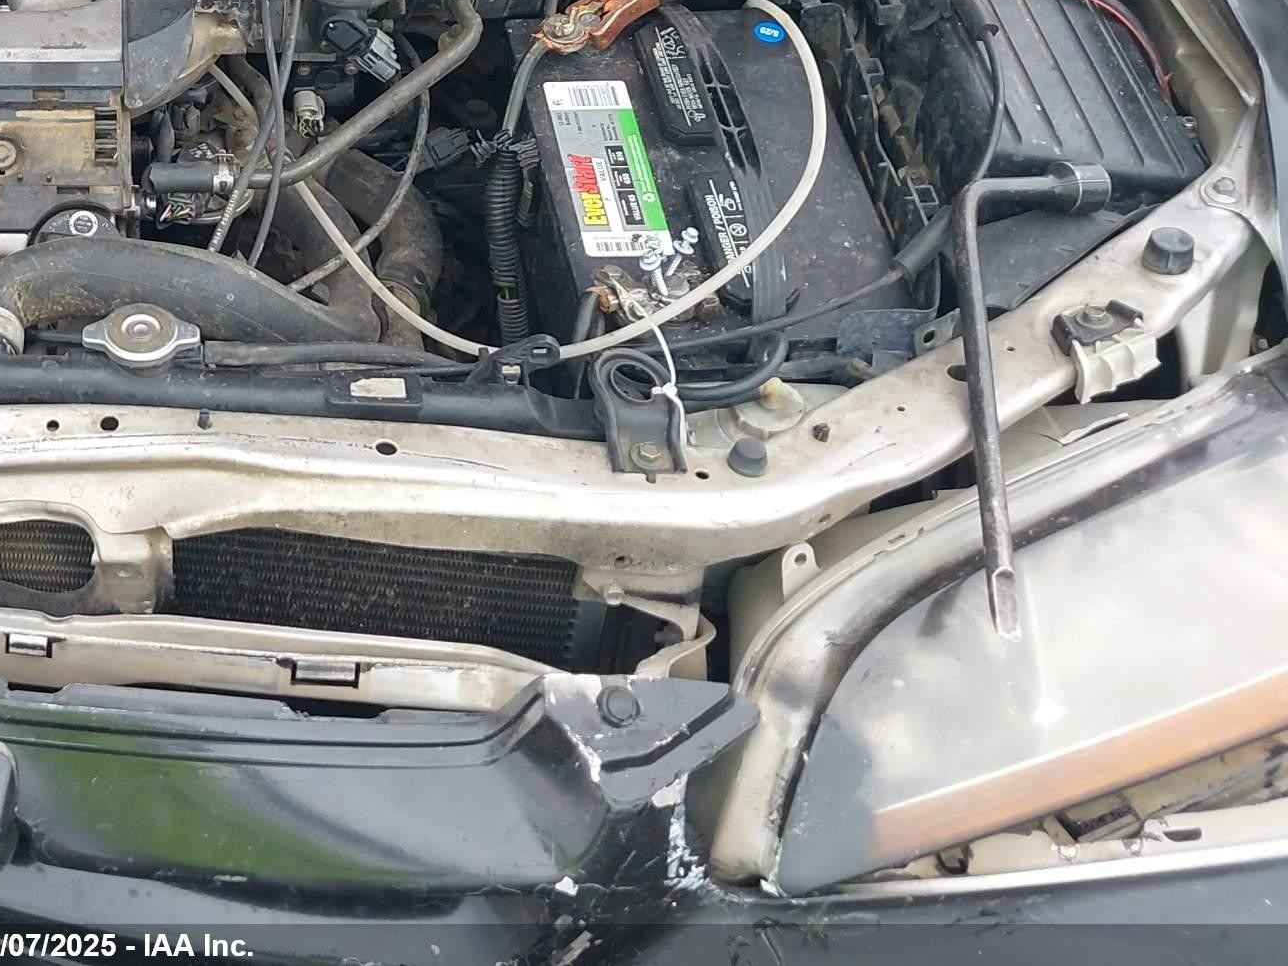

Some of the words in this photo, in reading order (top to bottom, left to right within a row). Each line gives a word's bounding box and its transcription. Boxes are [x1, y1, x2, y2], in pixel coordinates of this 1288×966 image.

[594, 160, 607, 181] VALUE
[564, 154, 609, 225] EverStart
[629, 202, 642, 220] VALUE
[704, 194, 722, 224] POISON
